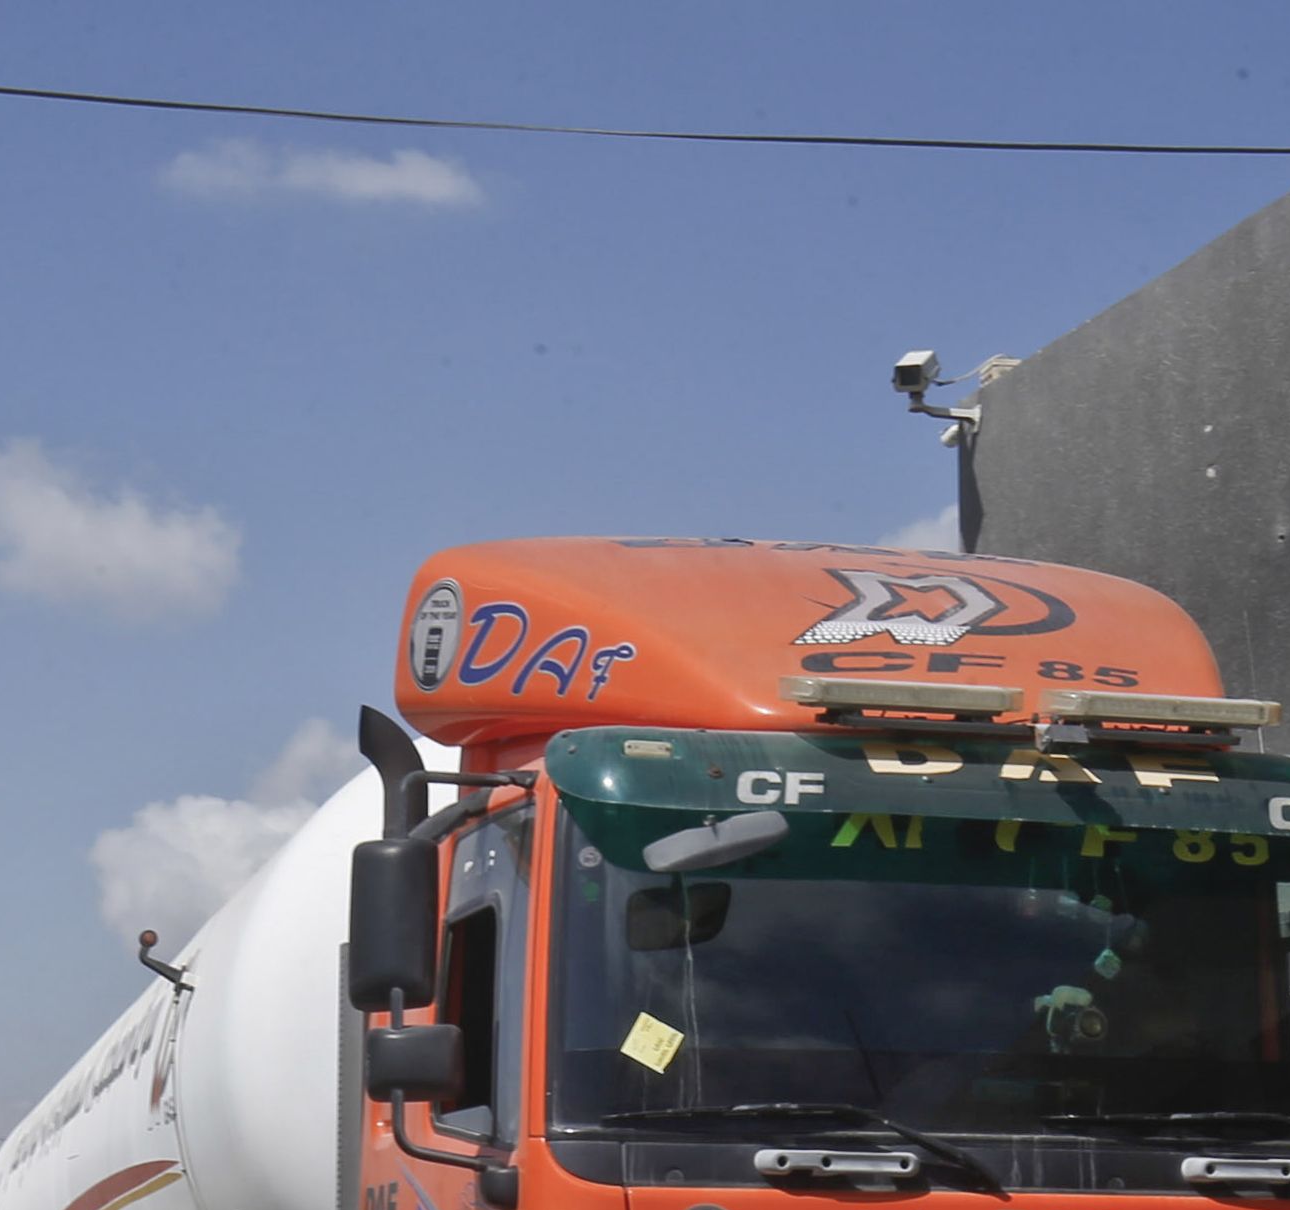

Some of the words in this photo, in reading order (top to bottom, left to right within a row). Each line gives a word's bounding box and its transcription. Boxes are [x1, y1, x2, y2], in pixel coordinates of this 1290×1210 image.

[801, 651, 1006, 673] CF
[1037, 660, 1140, 688] 85
[736, 769, 825, 806] CF
